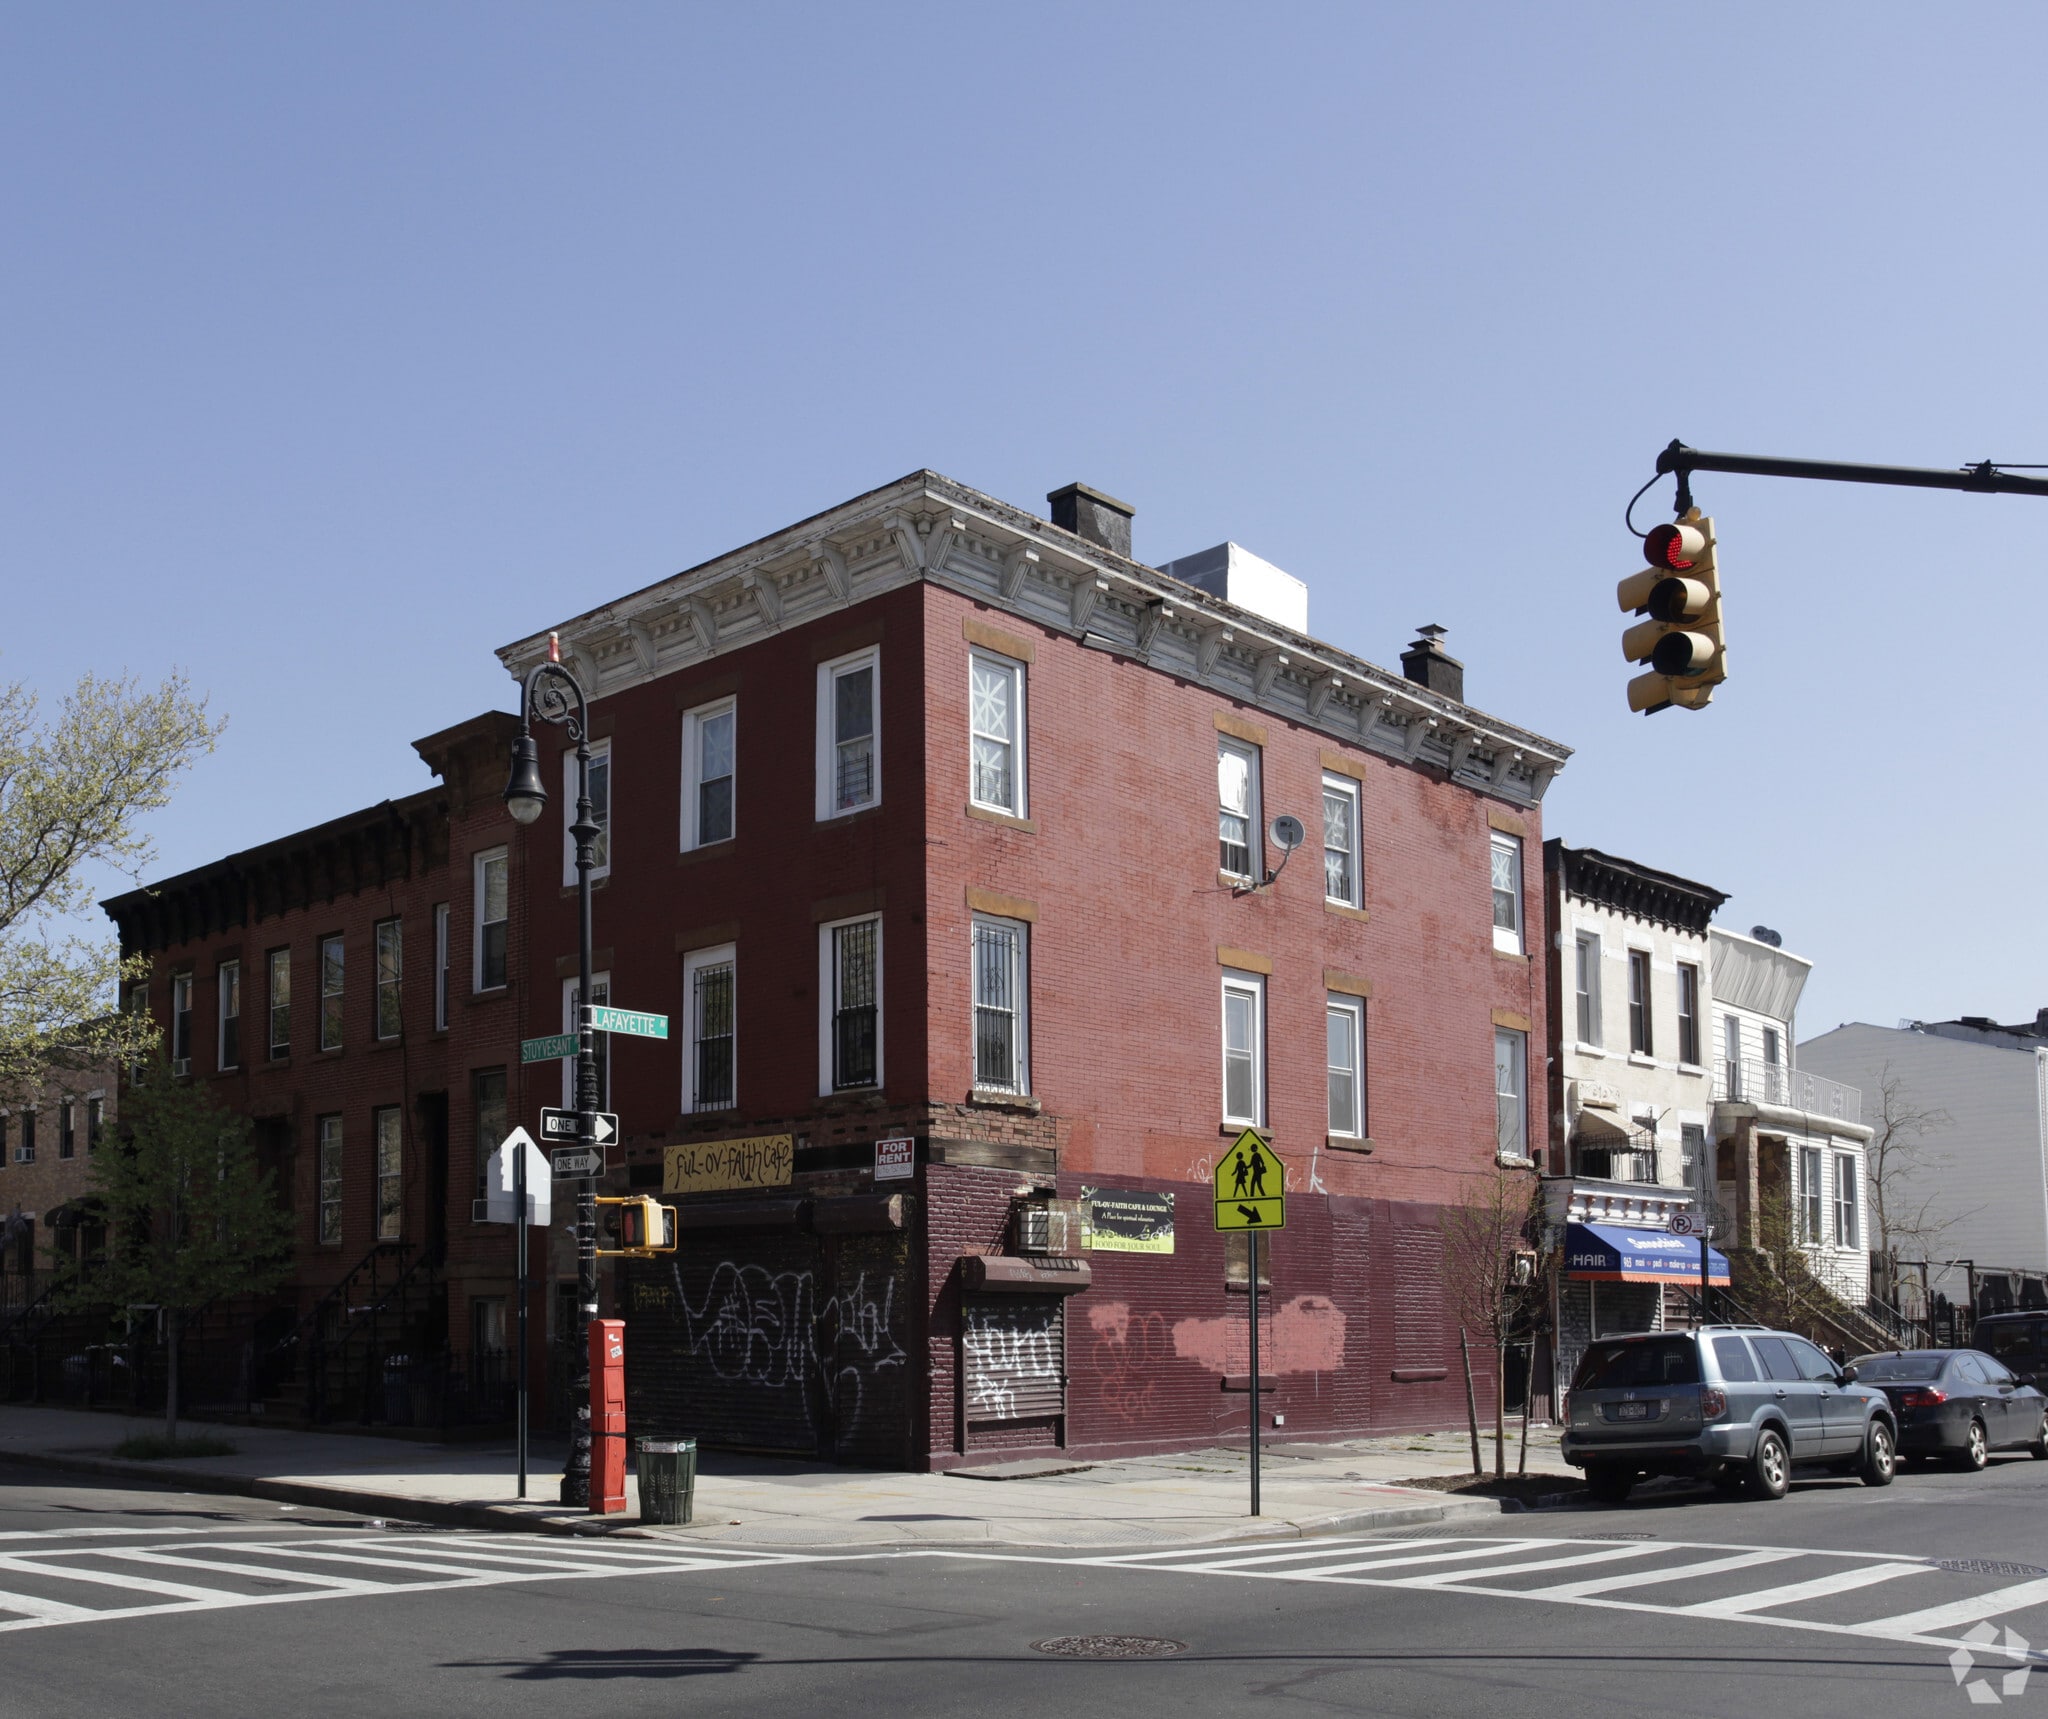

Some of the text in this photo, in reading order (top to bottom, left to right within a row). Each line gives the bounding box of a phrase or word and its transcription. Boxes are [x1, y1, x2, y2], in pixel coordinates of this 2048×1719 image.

[595, 1009, 656, 1035] LAFAYETTE
[522, 1037, 572, 1060] STUYVESANT
[550, 1118, 571, 1132] ONE
[882, 1142, 907, 1154] FOR
[557, 1157, 589, 1170] ONE WAY
[878, 1152, 911, 1165] RENT
[1146, 1205, 1168, 1213] LOUNGE
[1095, 1240, 1160, 1251] FOOD FOR YOUR SOUL
